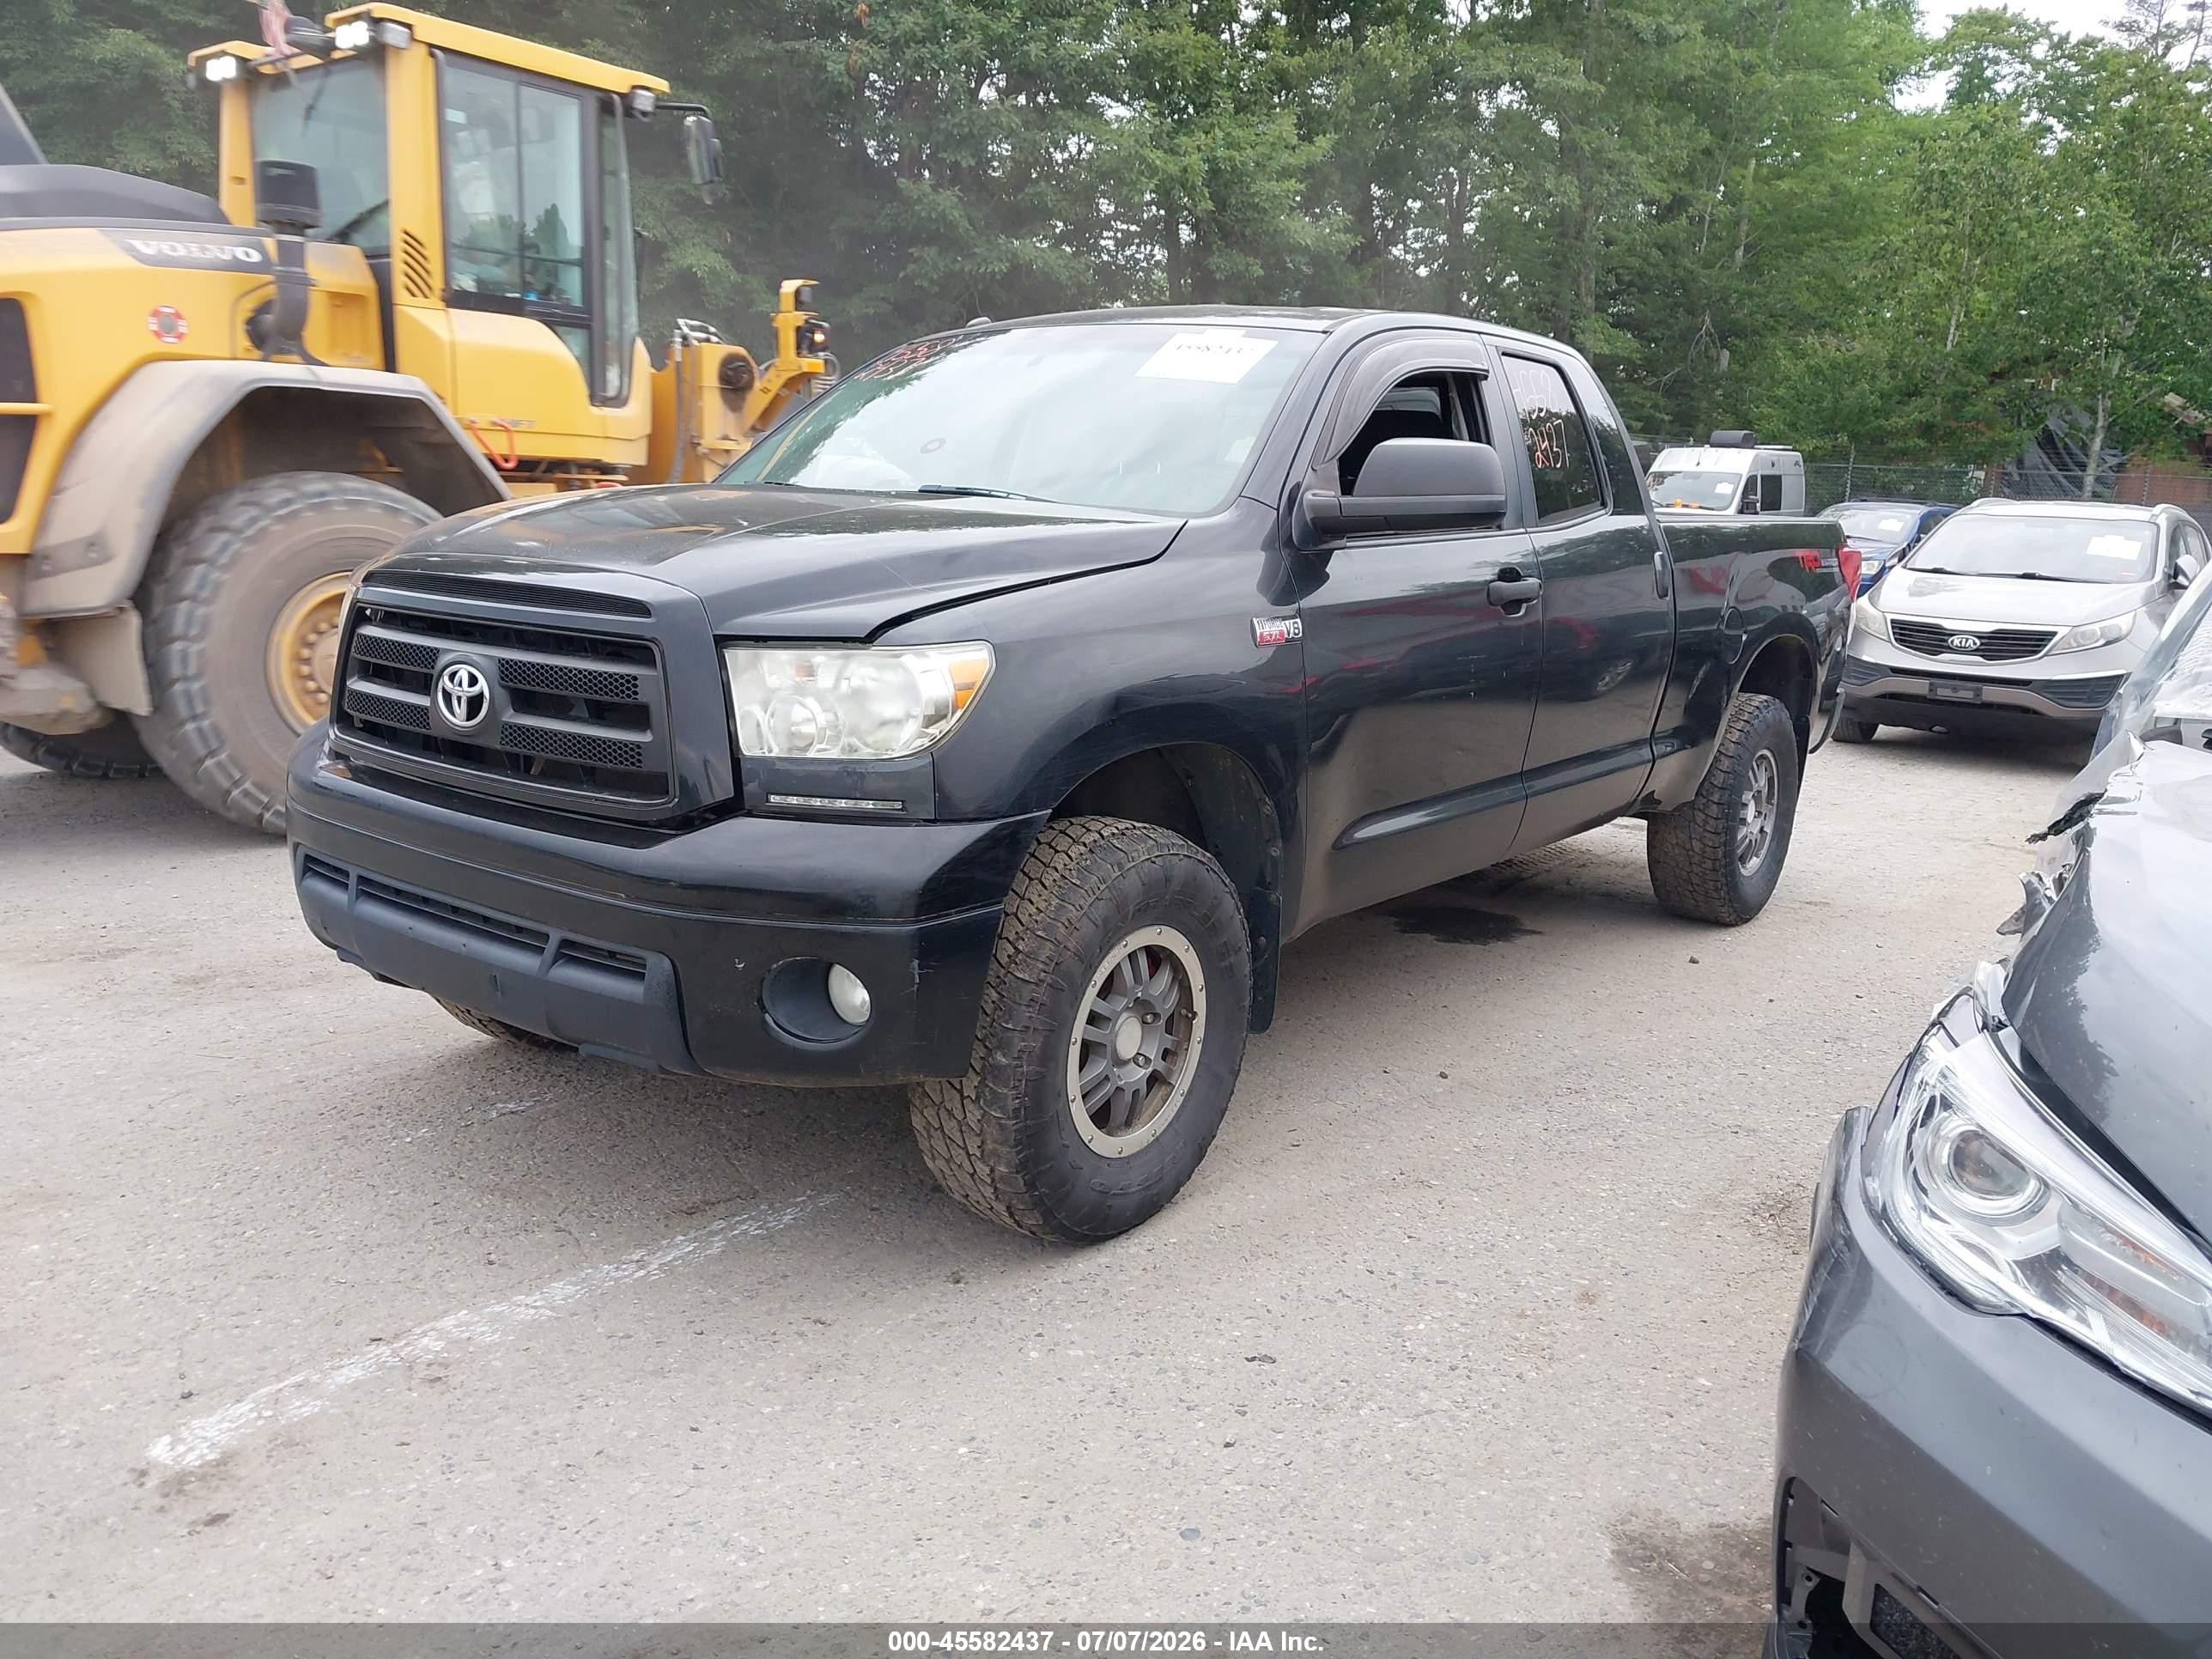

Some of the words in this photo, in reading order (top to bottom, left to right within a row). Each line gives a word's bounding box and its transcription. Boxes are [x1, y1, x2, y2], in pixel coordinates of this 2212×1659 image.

[125, 239, 263, 263] VOLVO
[1284, 620, 1300, 637] V8
[1953, 638, 1976, 647] KIA
